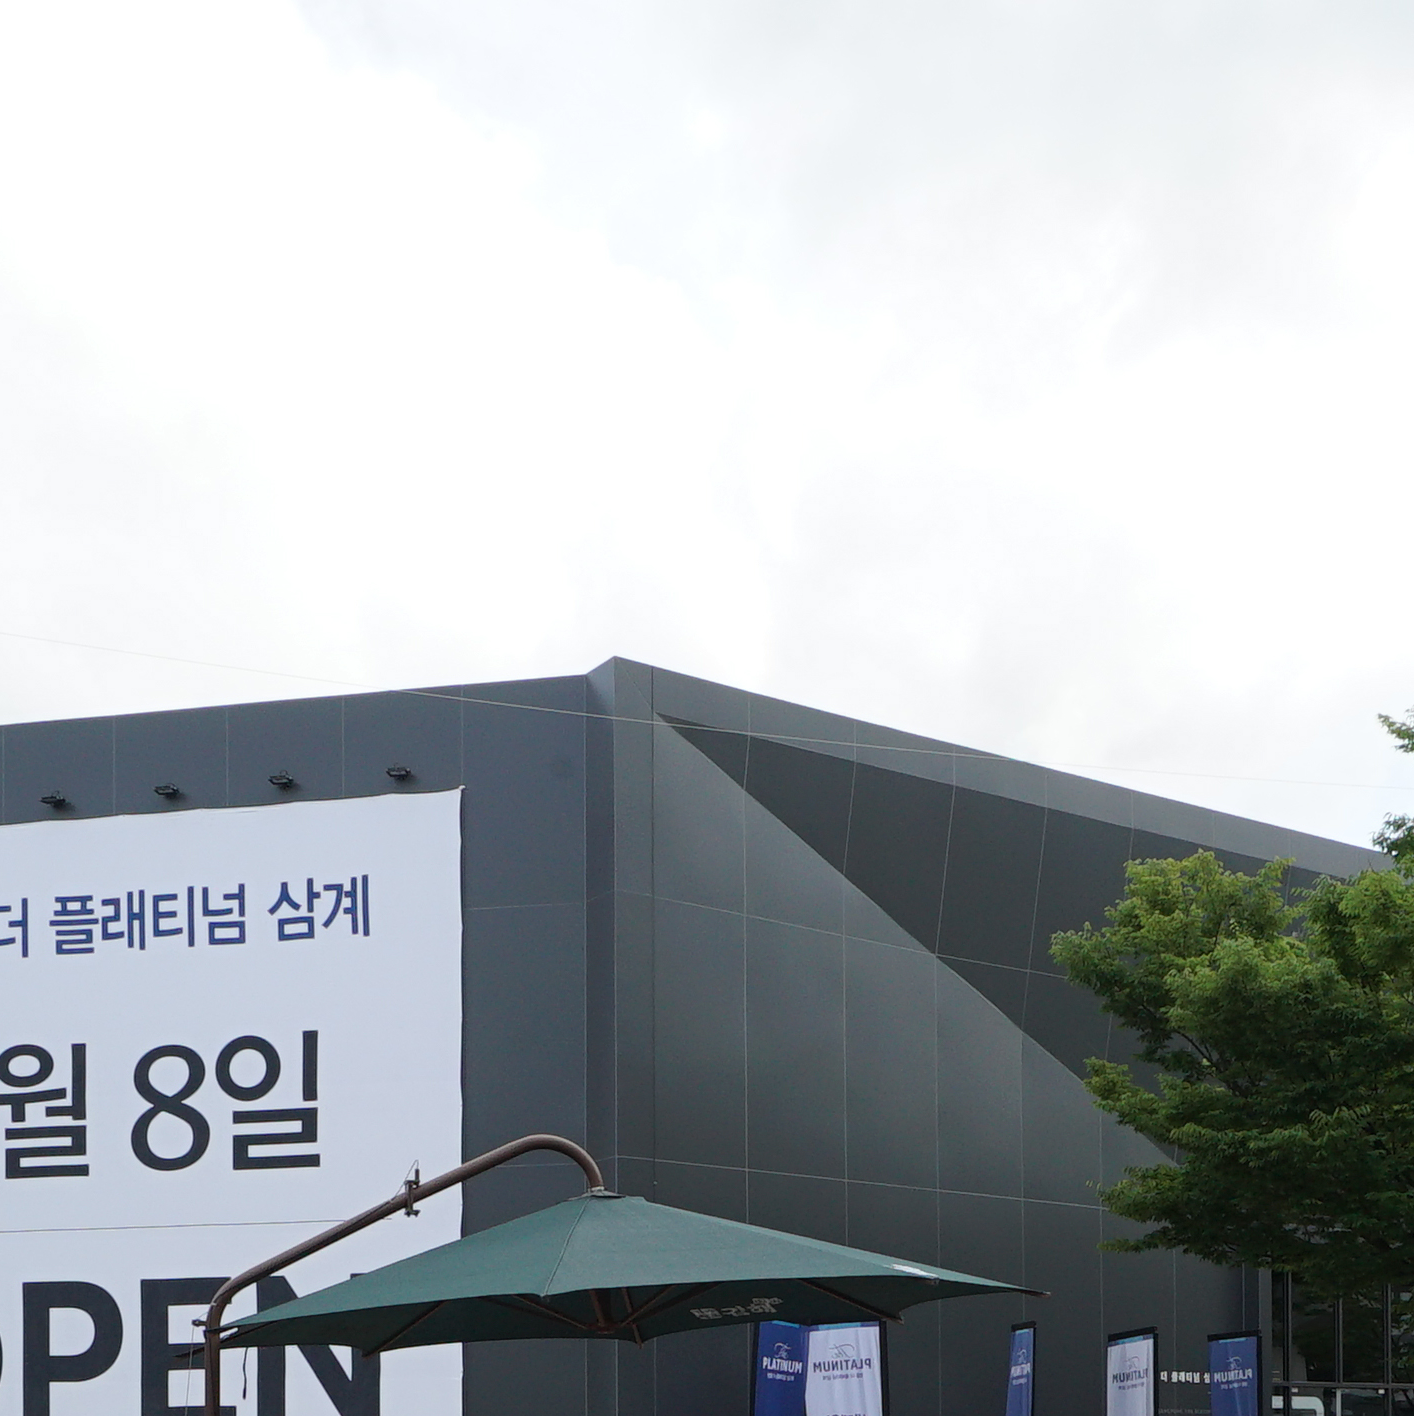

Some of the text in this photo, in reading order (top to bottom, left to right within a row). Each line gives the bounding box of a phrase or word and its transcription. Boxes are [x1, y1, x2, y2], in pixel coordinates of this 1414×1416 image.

[48, 882, 248, 956] 플래티넘
[267, 874, 372, 942] 삼계
[130, 1029, 321, 1172] 8일
